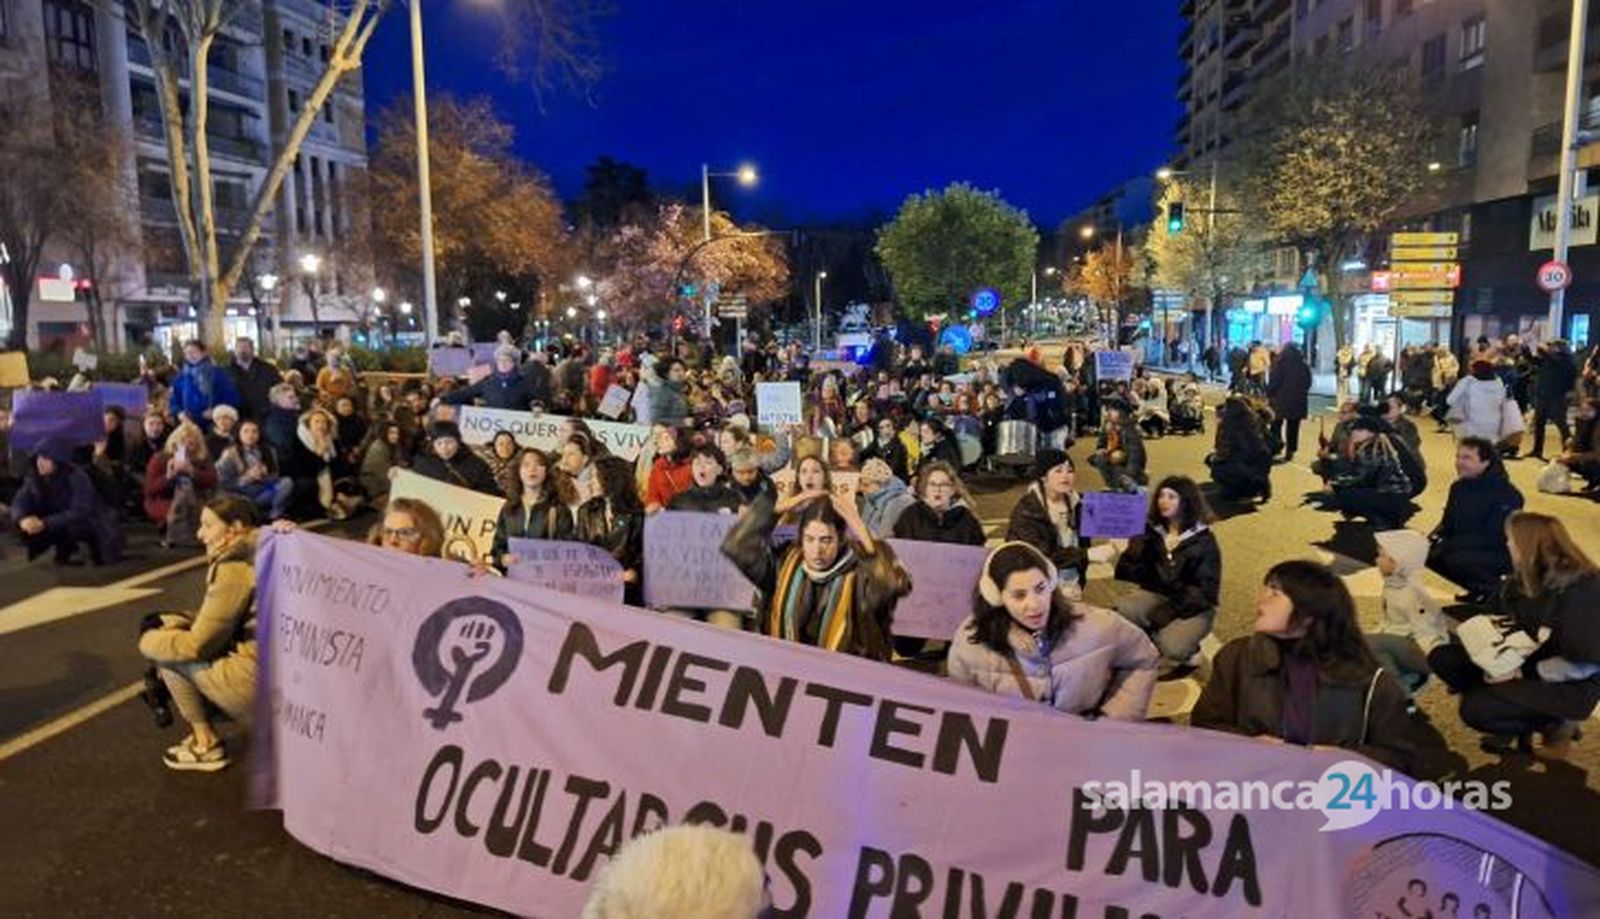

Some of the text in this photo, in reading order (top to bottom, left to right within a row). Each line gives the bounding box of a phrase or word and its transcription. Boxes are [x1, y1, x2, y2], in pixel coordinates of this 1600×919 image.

[464, 416, 503, 432] NOS
[614, 431, 650, 448] VIV
[547, 620, 1010, 784] MIENTEN
[1065, 786, 1262, 907] PARA
